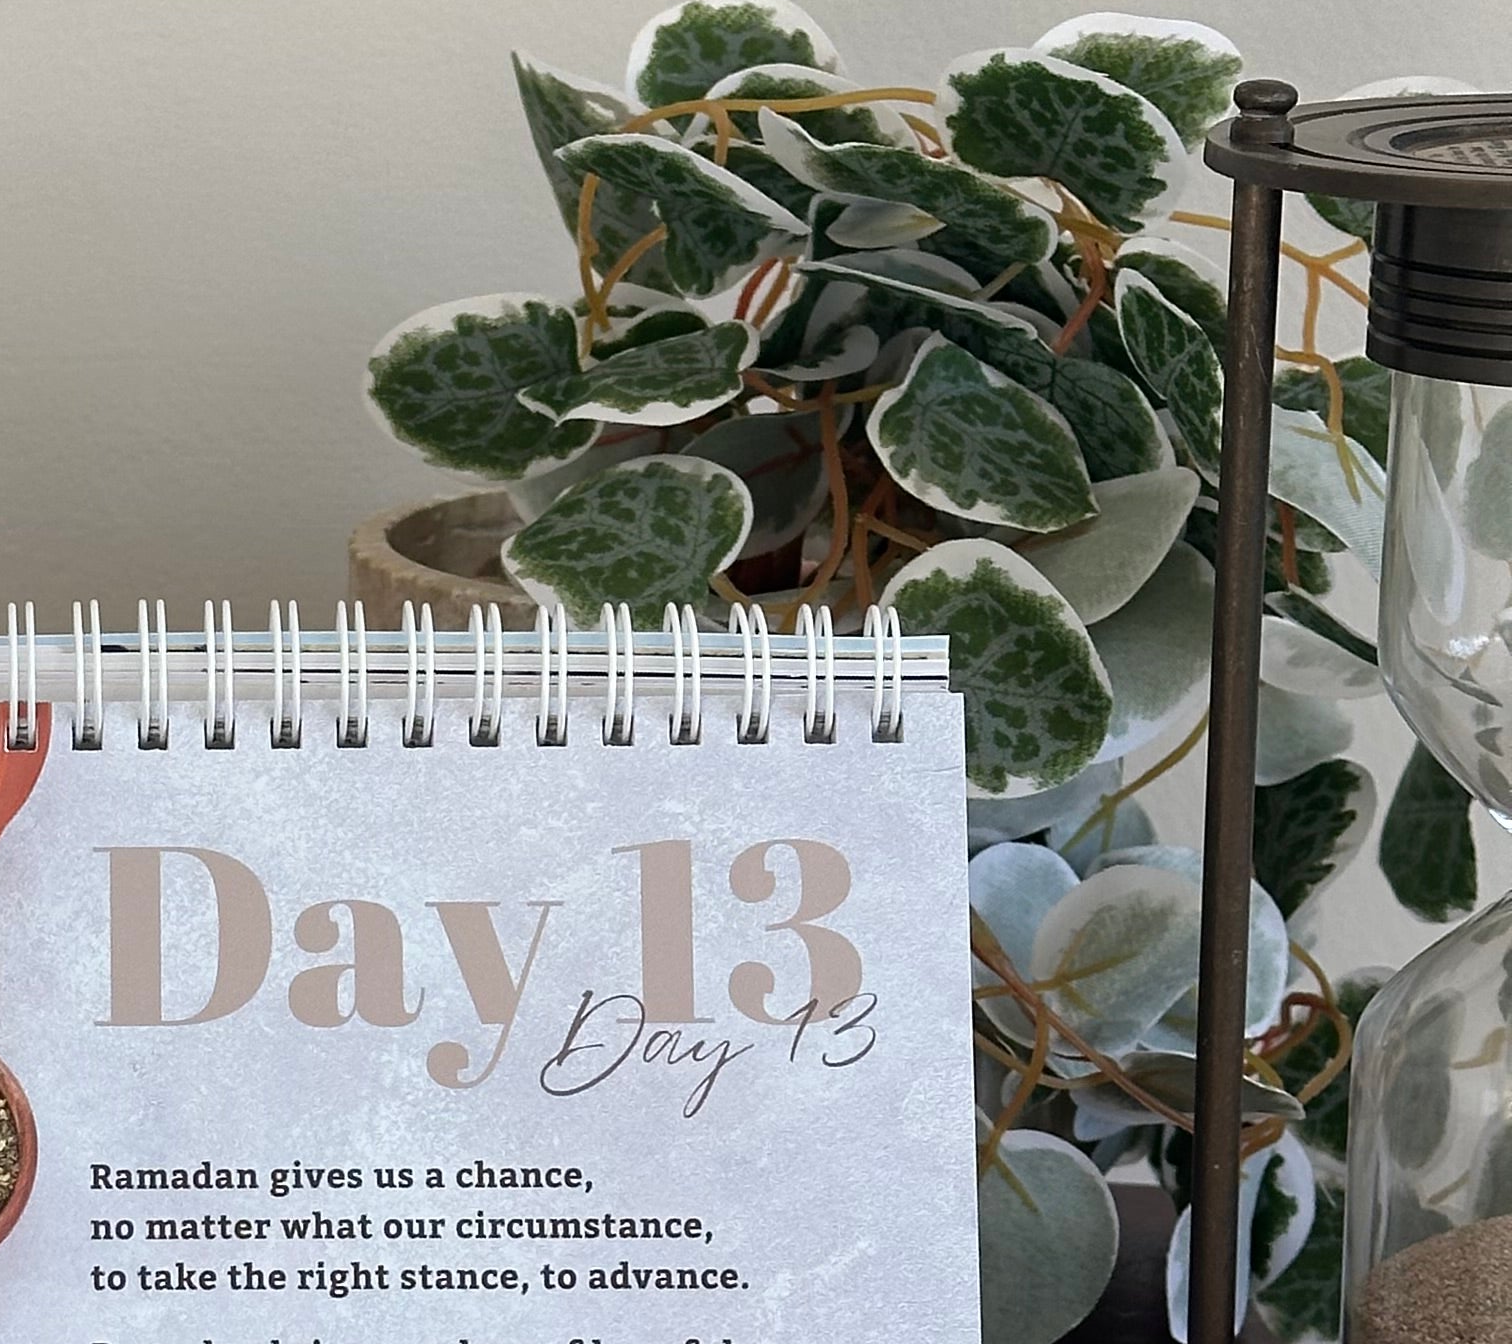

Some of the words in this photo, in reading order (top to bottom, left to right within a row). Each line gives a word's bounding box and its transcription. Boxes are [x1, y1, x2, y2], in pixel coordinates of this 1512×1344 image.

[92, 845, 564, 1090] Day
[610, 837, 865, 1027] 13
[539, 989, 756, 1119] Day
[783, 992, 879, 1068] 13
[90, 1161, 259, 1190] Ramadan
[269, 1160, 363, 1198] gives
[373, 1168, 414, 1189] us
[425, 1168, 446, 1189] a
[456, 1160, 593, 1194] chance,
[90, 1219, 134, 1240] no
[145, 1214, 271, 1240] matter
[280, 1211, 373, 1240] what
[383, 1218, 446, 1239] our
[456, 1210, 713, 1245] circumstance,
[90, 1265, 127, 1291] to
[137, 1262, 217, 1291] take
[226, 1261, 286, 1291] the
[297, 1261, 390, 1299] right
[400, 1264, 529, 1296] stance,
[540, 1263, 577, 1290] to
[588, 1261, 749, 1290] advance.
